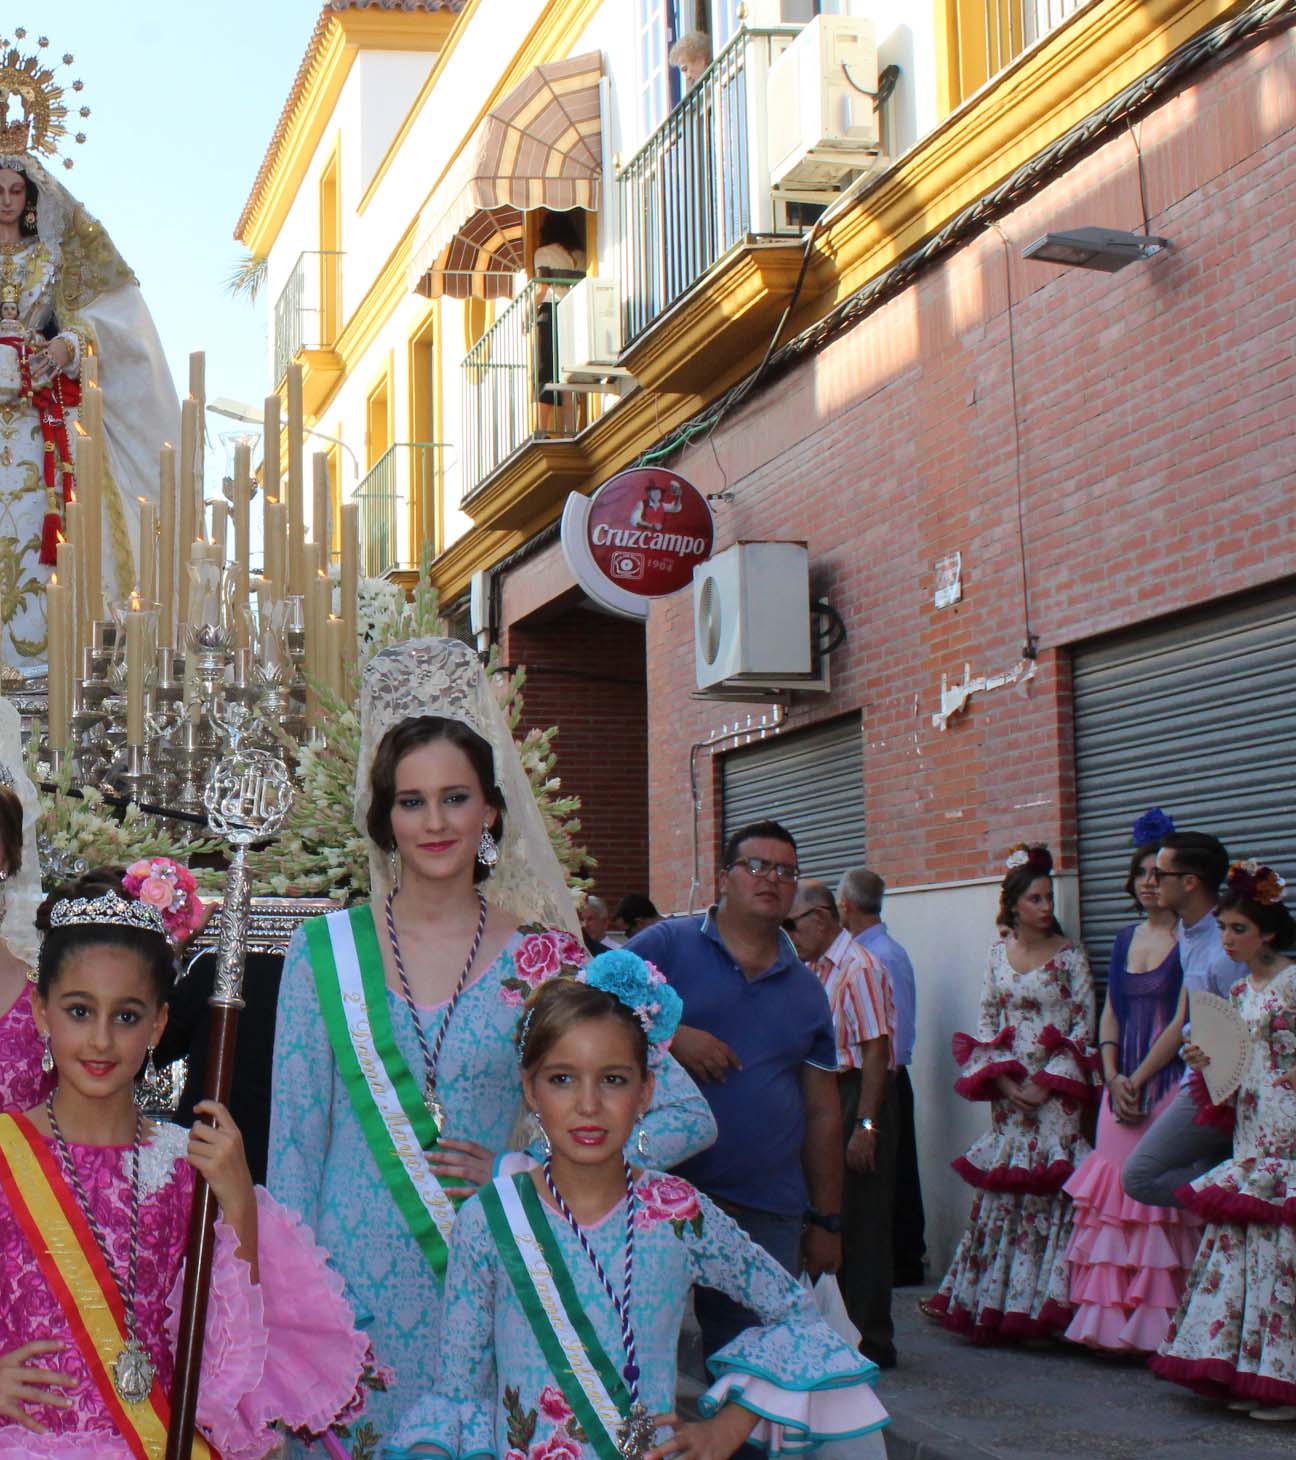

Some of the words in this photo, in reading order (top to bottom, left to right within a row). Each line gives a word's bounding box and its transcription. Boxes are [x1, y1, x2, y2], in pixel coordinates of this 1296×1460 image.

[592, 523, 705, 557] Cruzcampo
[350, 1021, 385, 1095] Dama
[381, 1104, 425, 1181] Mayor
[529, 1260, 564, 1329] Dama
[561, 1336, 626, 1426] Infantil
